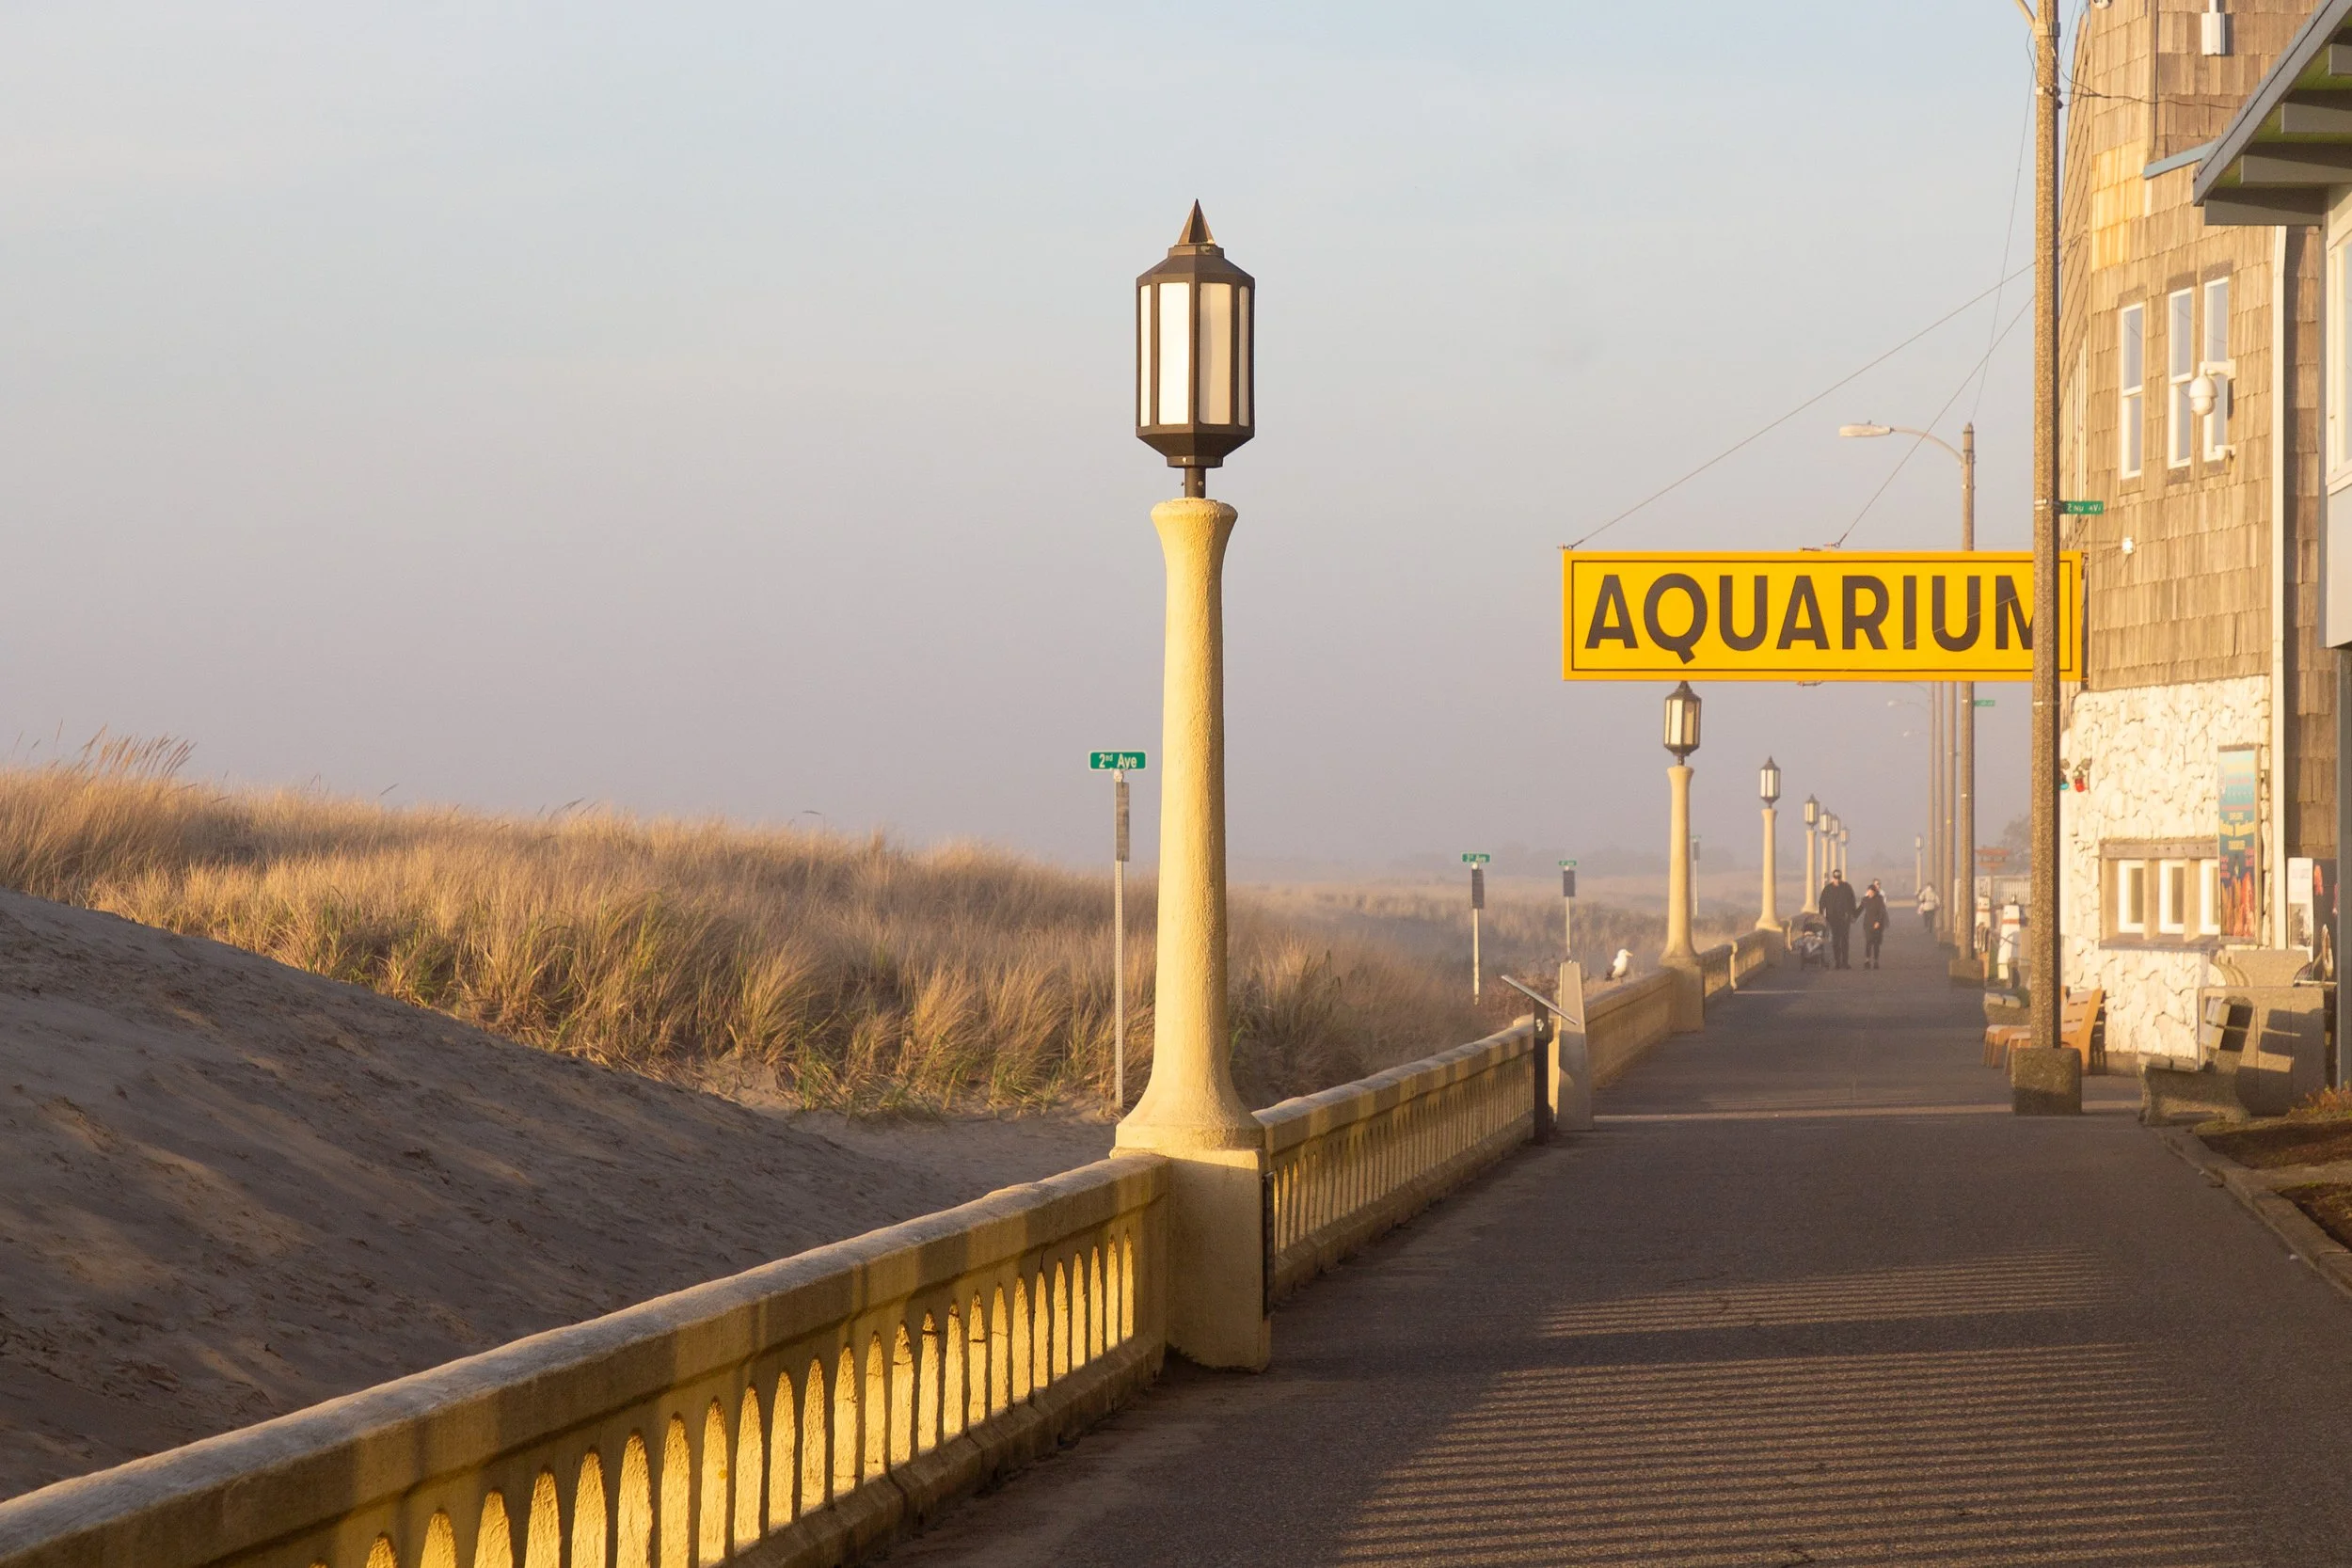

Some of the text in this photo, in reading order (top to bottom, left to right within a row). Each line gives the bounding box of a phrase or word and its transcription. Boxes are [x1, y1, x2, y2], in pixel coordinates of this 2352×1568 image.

[1584, 573, 2034, 665] AQUARIUM
[1099, 753, 1137, 768] 2nd Ave
